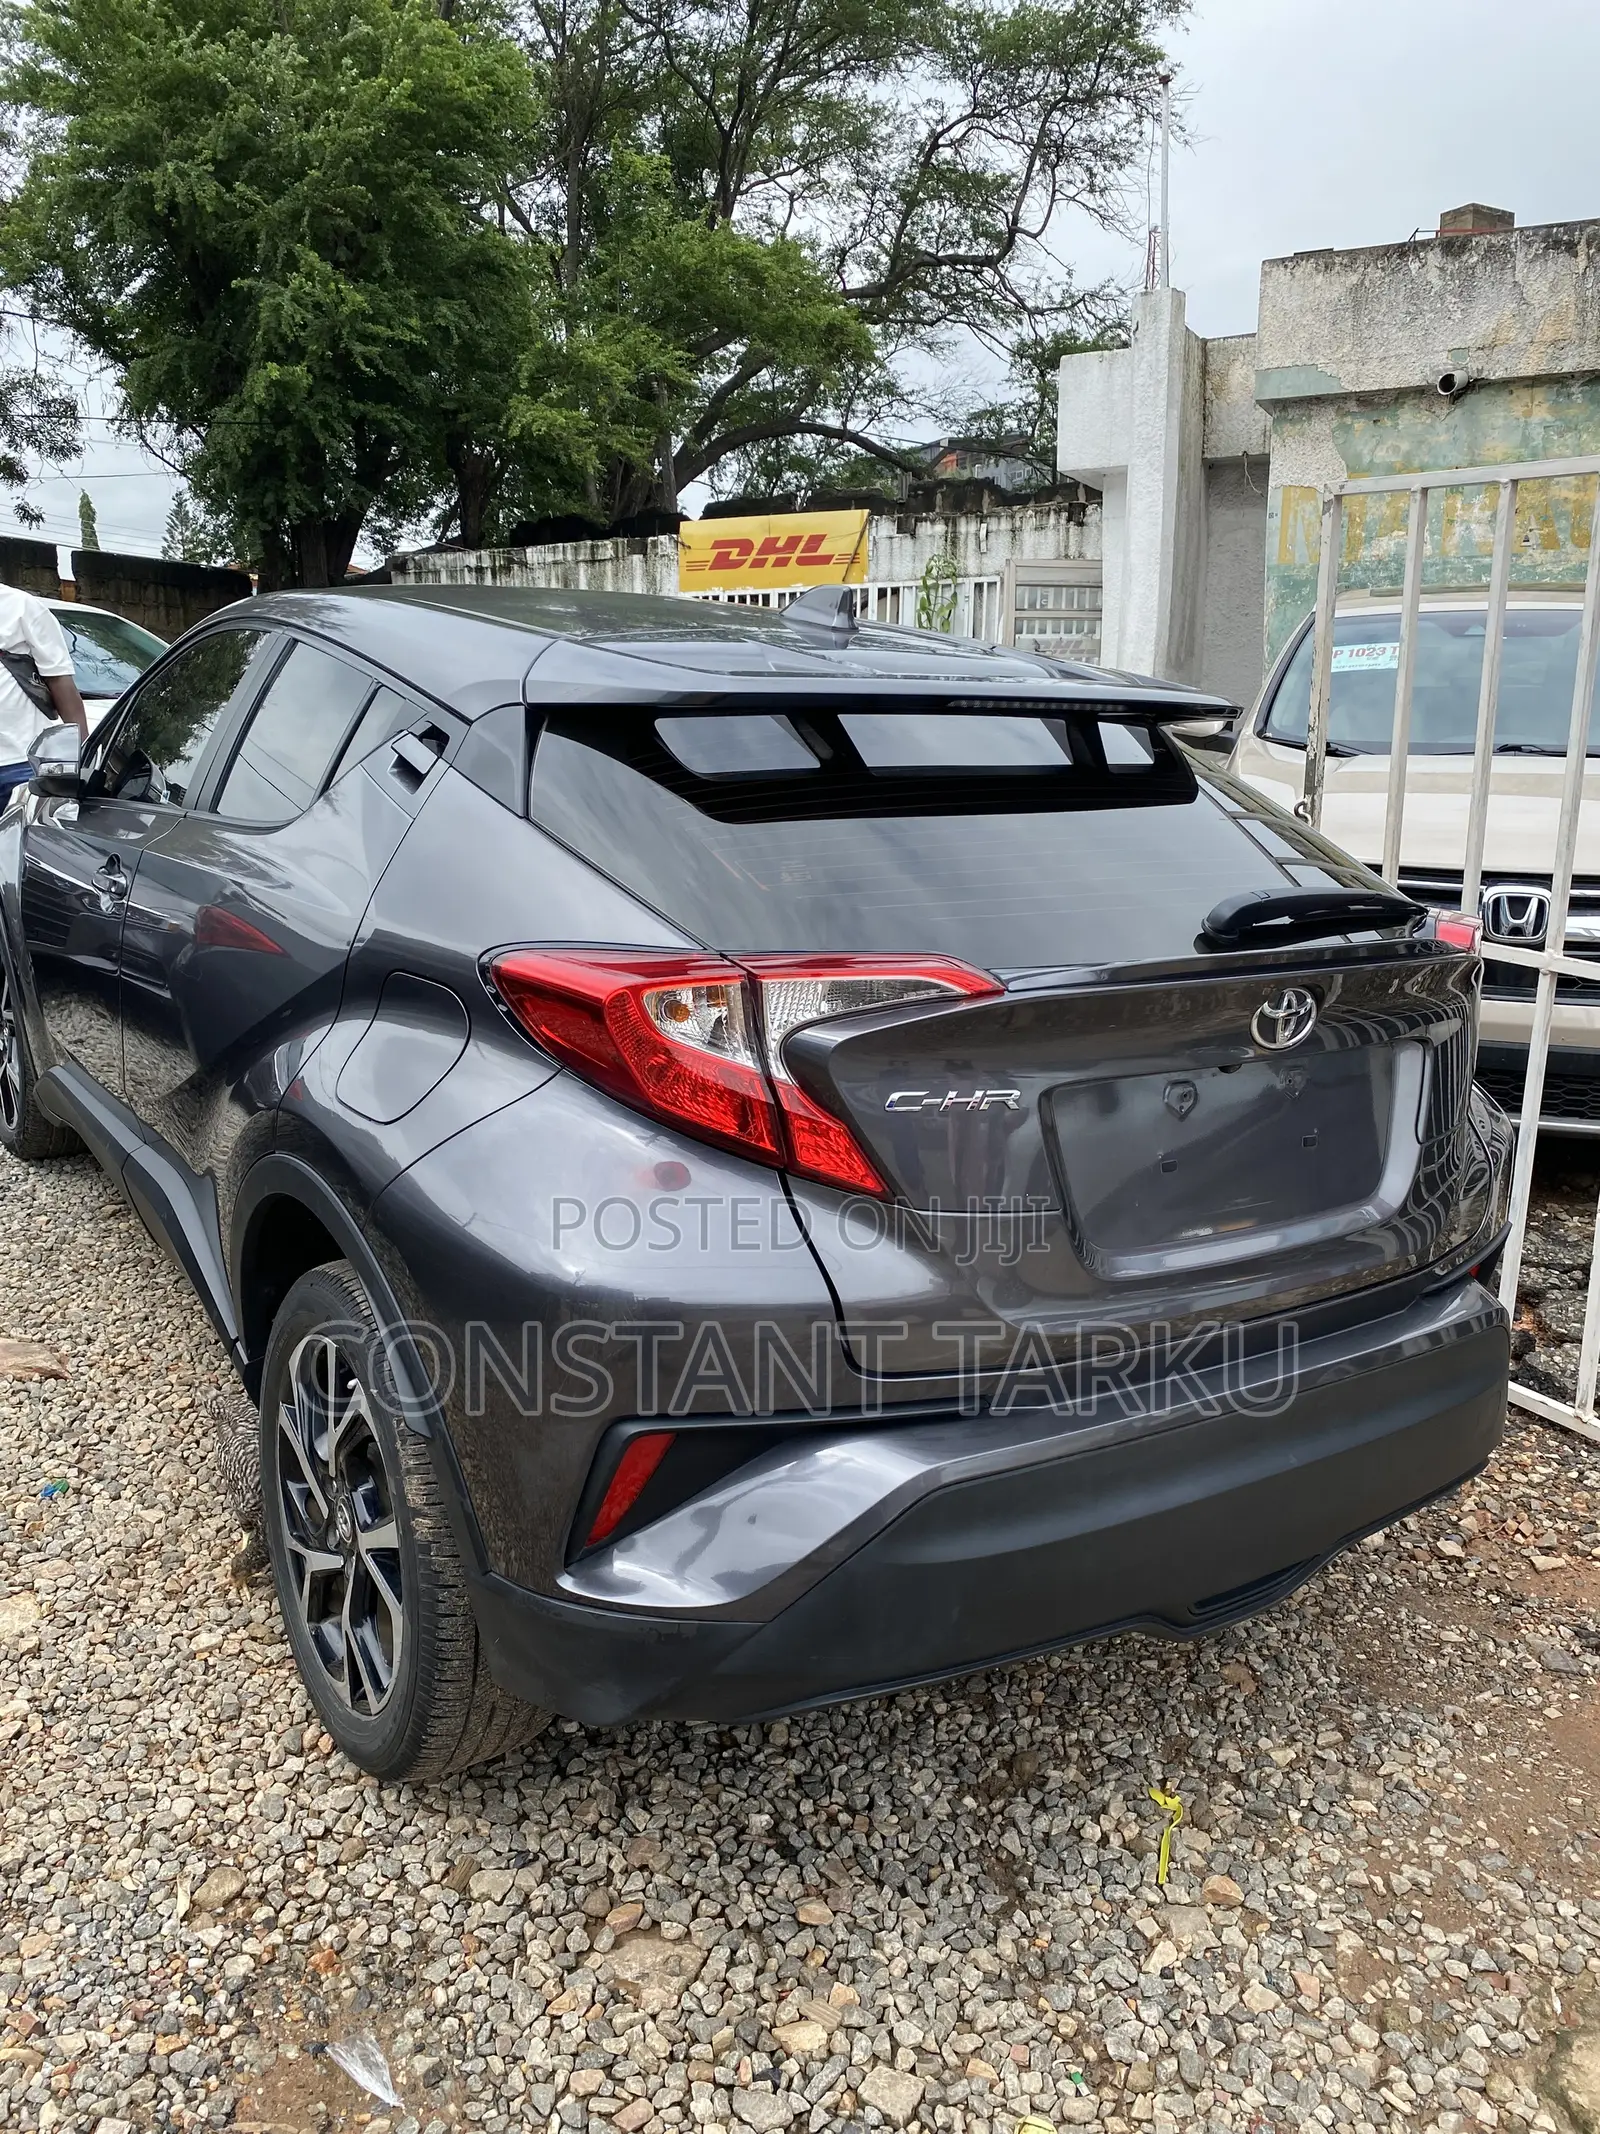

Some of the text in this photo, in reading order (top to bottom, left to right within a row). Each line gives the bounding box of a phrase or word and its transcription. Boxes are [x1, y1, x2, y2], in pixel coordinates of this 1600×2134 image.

[708, 534, 835, 570] DHL
[1348, 646, 1386, 657] 1023
[884, 1089, 1021, 1112] C-HR
